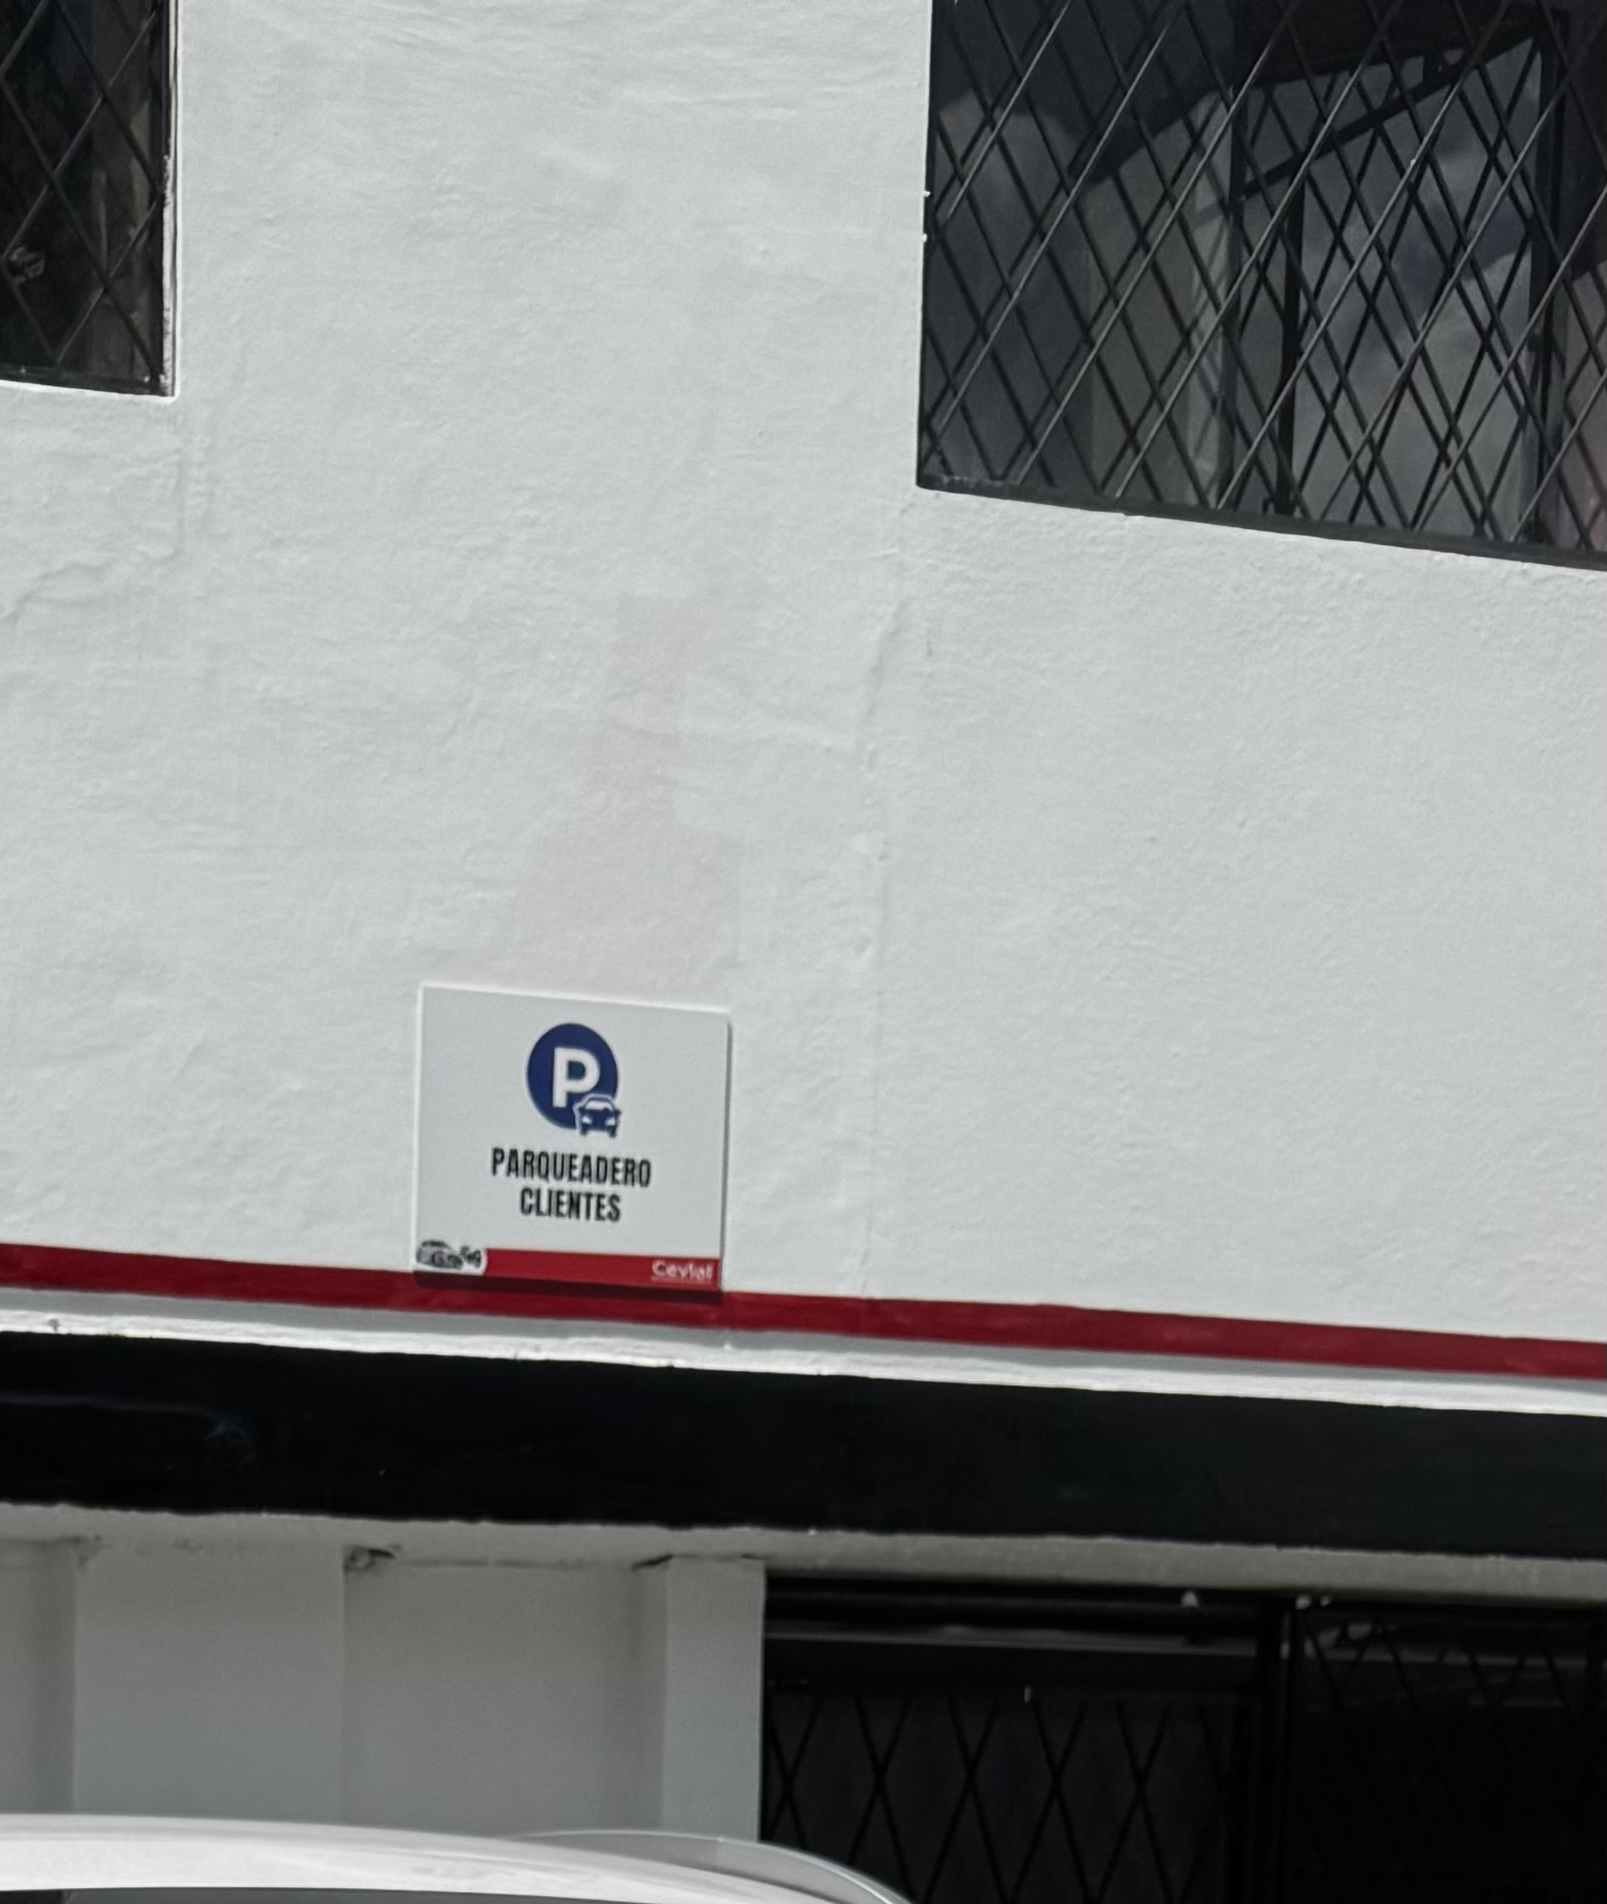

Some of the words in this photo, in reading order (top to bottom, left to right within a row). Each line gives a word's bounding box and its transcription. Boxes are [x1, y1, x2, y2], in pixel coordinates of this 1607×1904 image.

[552, 1047, 600, 1108] P
[491, 1147, 652, 1188] PARQUEADERO
[520, 1187, 622, 1222] CLIENTES
